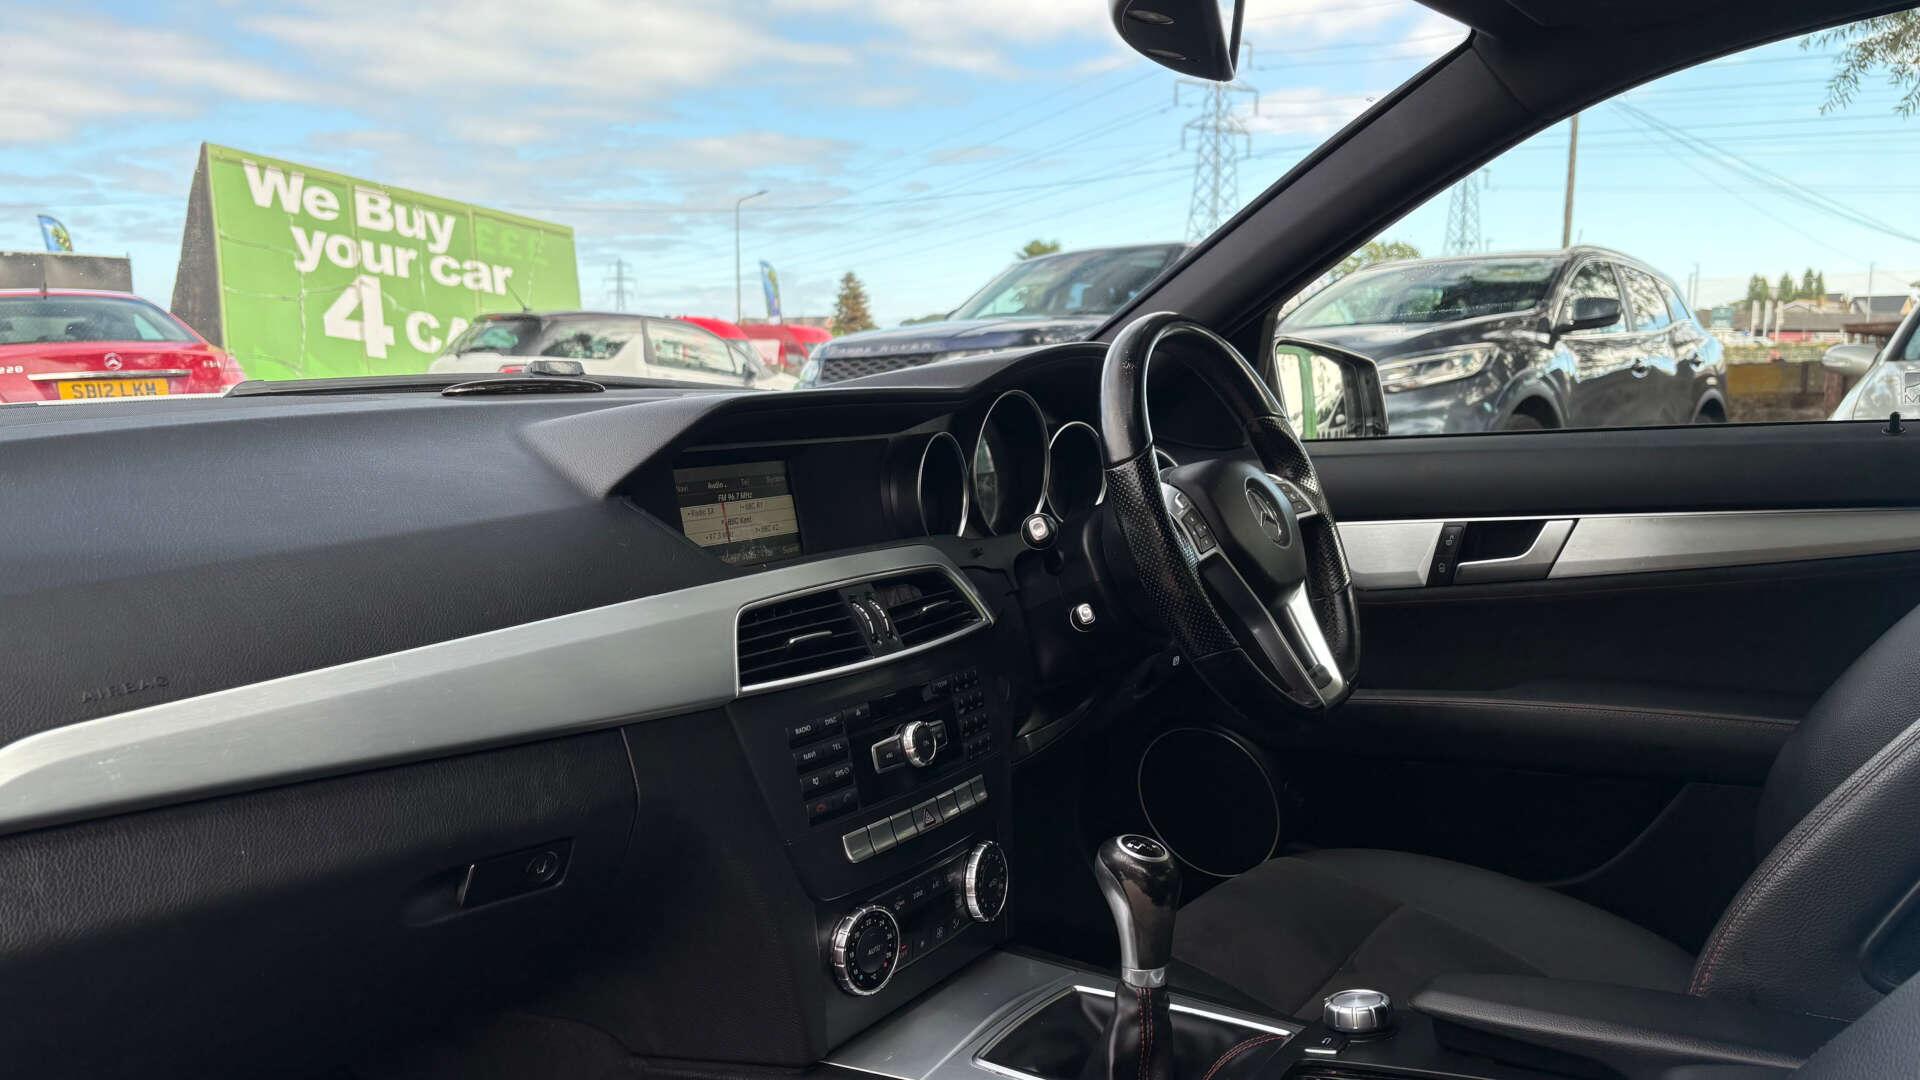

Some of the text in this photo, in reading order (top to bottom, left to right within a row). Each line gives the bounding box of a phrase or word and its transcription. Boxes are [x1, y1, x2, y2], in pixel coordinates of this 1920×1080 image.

[243, 159, 457, 254] We Buy
[290, 225, 513, 296] your car
[323, 274, 395, 359] 4
[71, 383, 113, 399] SB12
